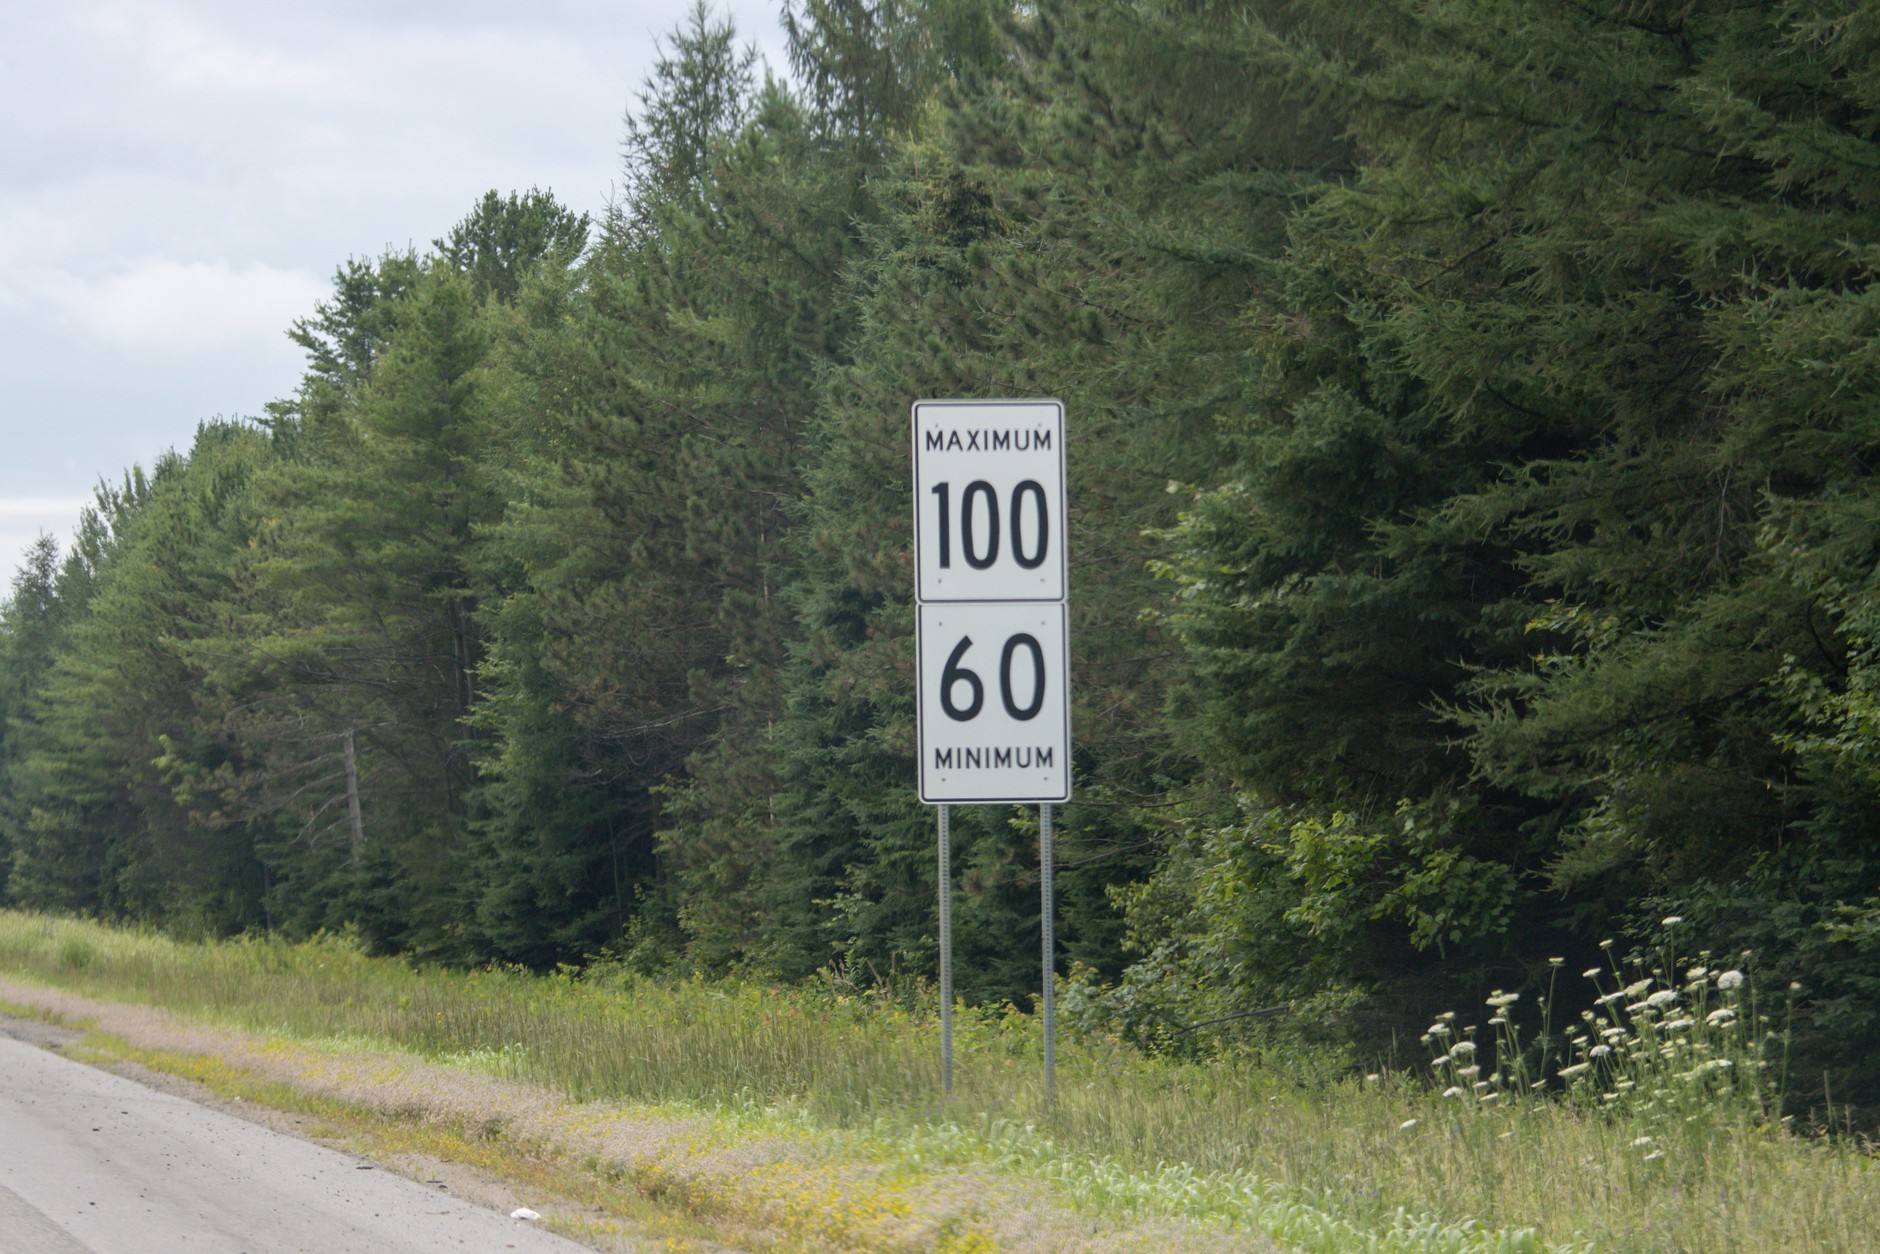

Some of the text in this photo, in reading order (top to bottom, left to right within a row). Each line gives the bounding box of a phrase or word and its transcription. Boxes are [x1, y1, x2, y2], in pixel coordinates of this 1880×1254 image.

[926, 429, 1052, 451] MAXIMUM
[931, 479, 1049, 570] 100
[940, 632, 1046, 722] 60
[935, 746, 1053, 770] MINIMUM
